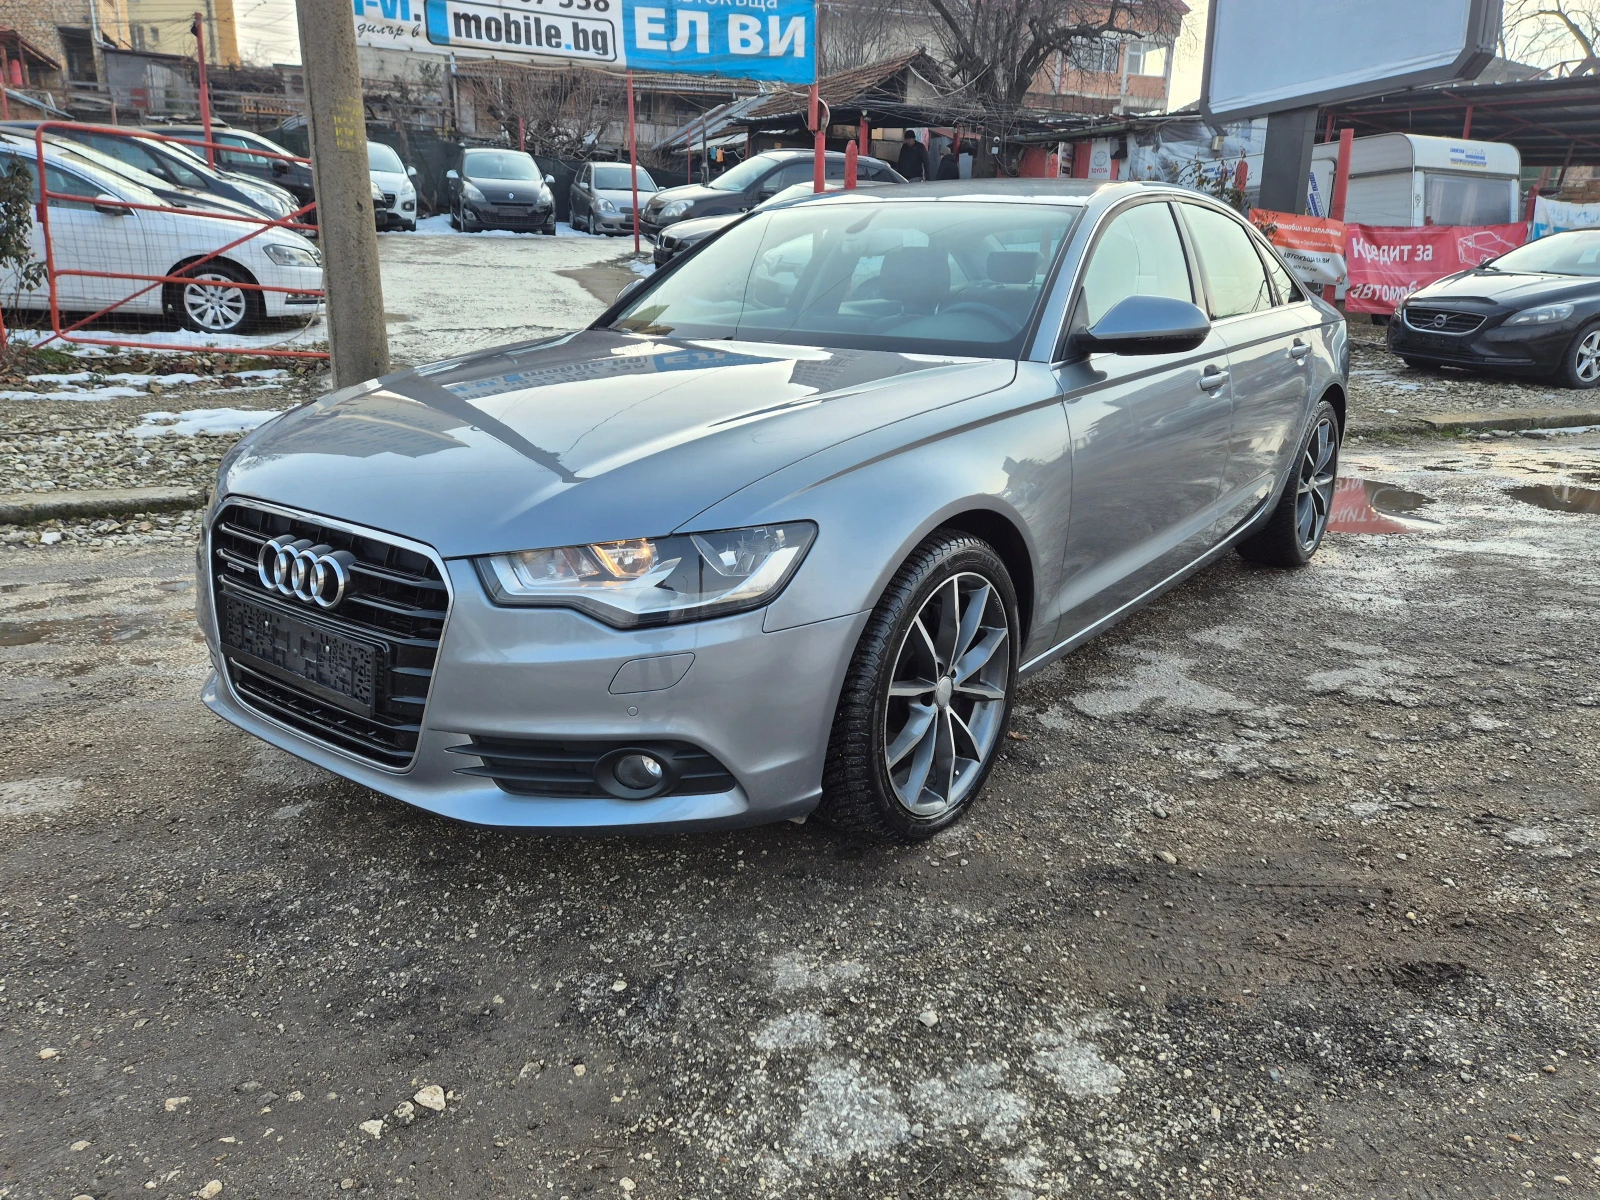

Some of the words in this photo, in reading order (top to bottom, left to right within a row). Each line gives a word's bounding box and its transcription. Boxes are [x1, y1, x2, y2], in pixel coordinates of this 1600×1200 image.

[453, 12, 609, 56] mobile.bg
[634, 7, 710, 54] ЕЛ
[728, 13, 806, 58] ВИ
[1352, 237, 1412, 266] Кредит
[1414, 244, 1433, 262] за
[1350, 281, 1420, 301] автомоб
